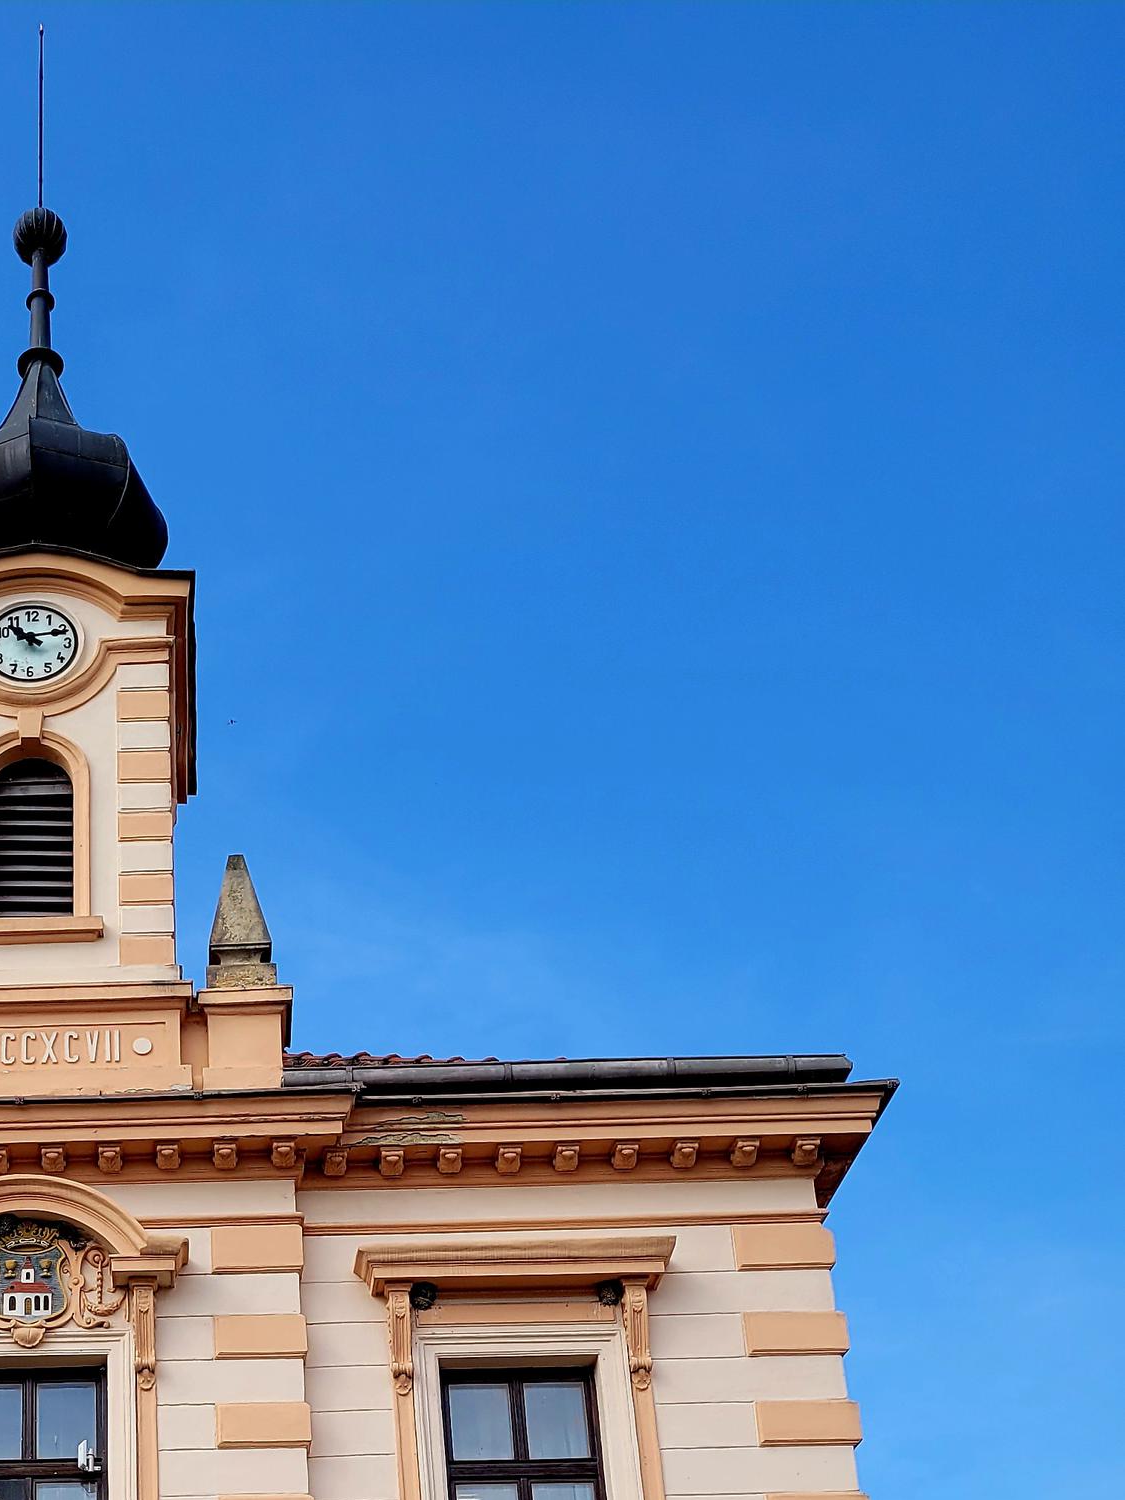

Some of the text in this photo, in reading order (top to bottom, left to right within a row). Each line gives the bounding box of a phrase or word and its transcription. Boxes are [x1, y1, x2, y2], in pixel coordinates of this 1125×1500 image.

[7, 615, 20, 628] 11
[24, 610, 39, 622] 12
[45, 614, 52, 626] 1
[63, 637, 72, 649] 3
[56, 651, 66, 663] 4
[9, 663, 18, 674] 7
[26, 666, 34, 677] 6
[43, 662, 53, 673] 5
